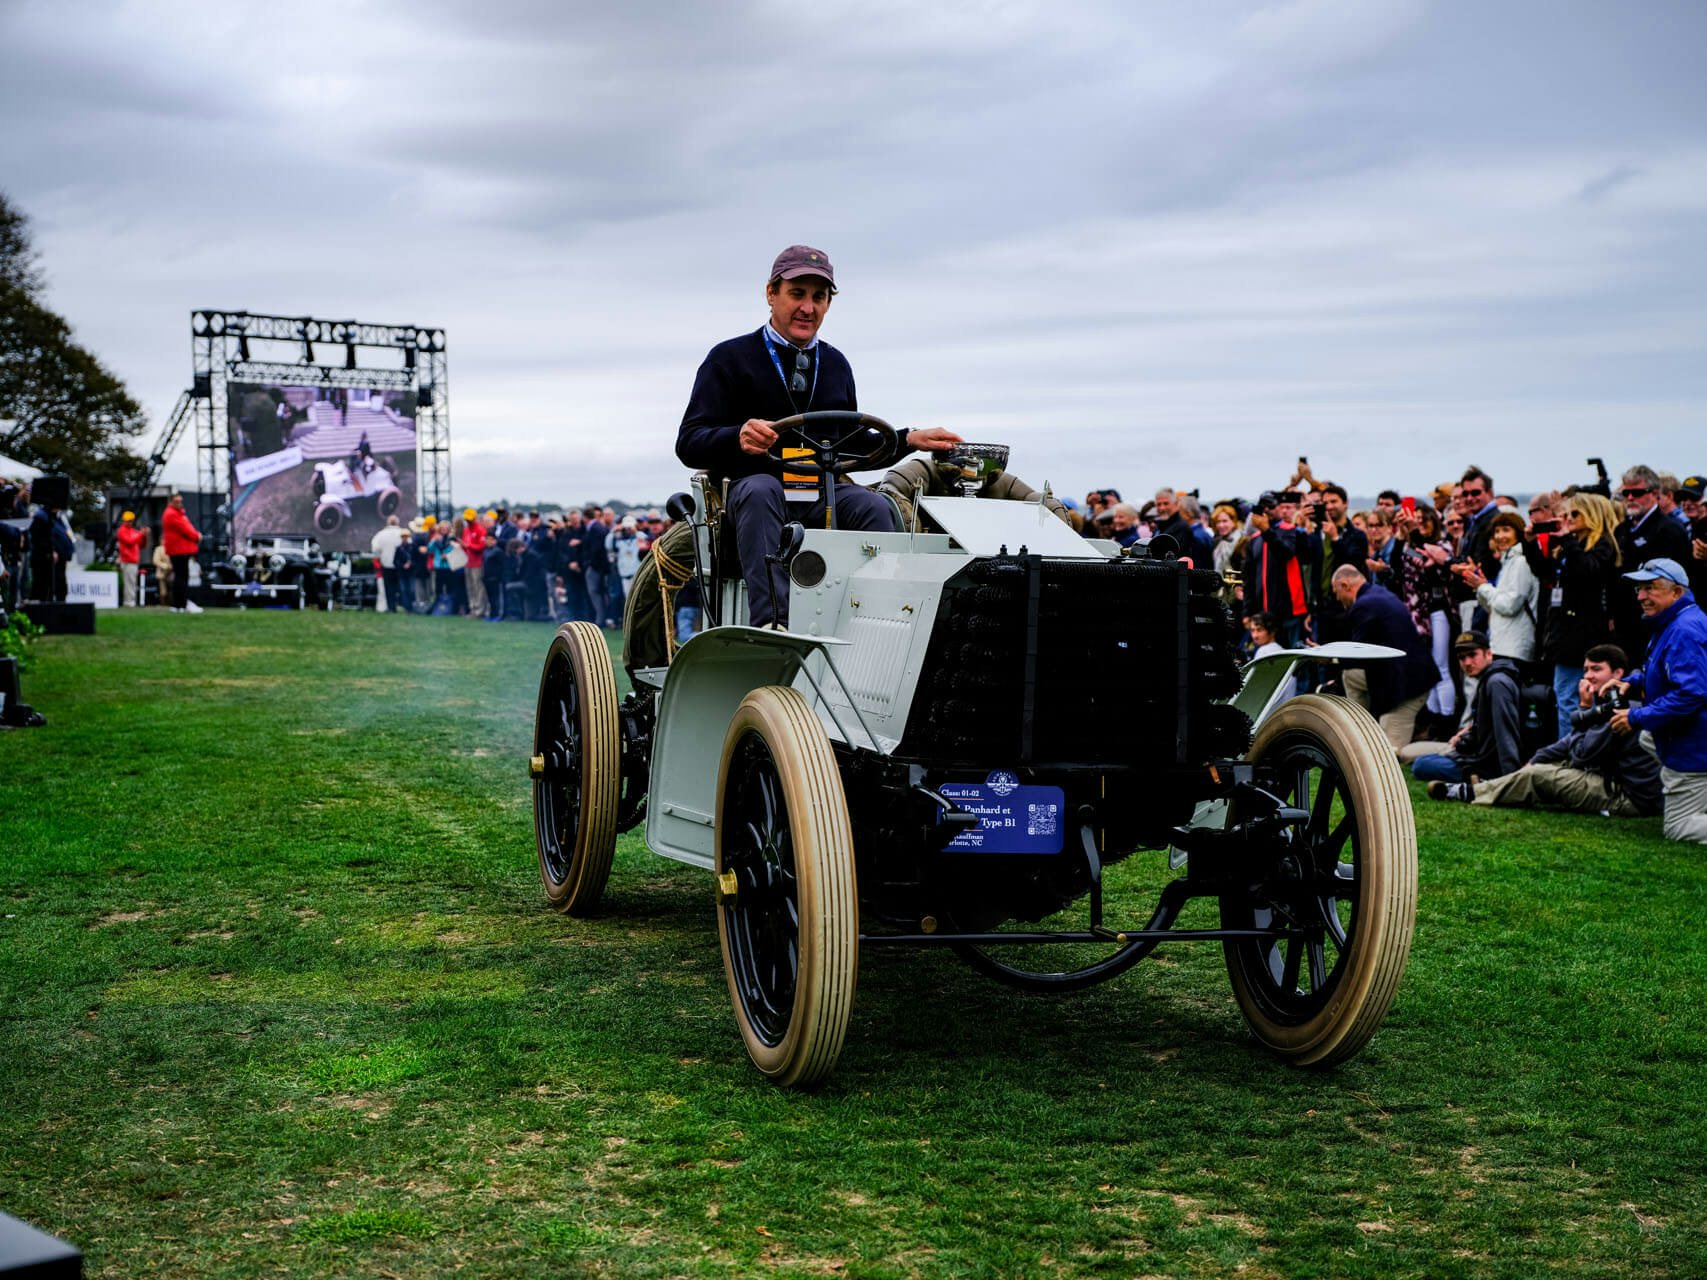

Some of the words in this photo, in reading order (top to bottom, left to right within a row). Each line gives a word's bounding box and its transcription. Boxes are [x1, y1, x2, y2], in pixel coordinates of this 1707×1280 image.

[964, 804, 1000, 814] Panhard
[980, 817, 1002, 829] Type
[1004, 818, 1016, 827] B1
[949, 839, 970, 847] arlotte,
